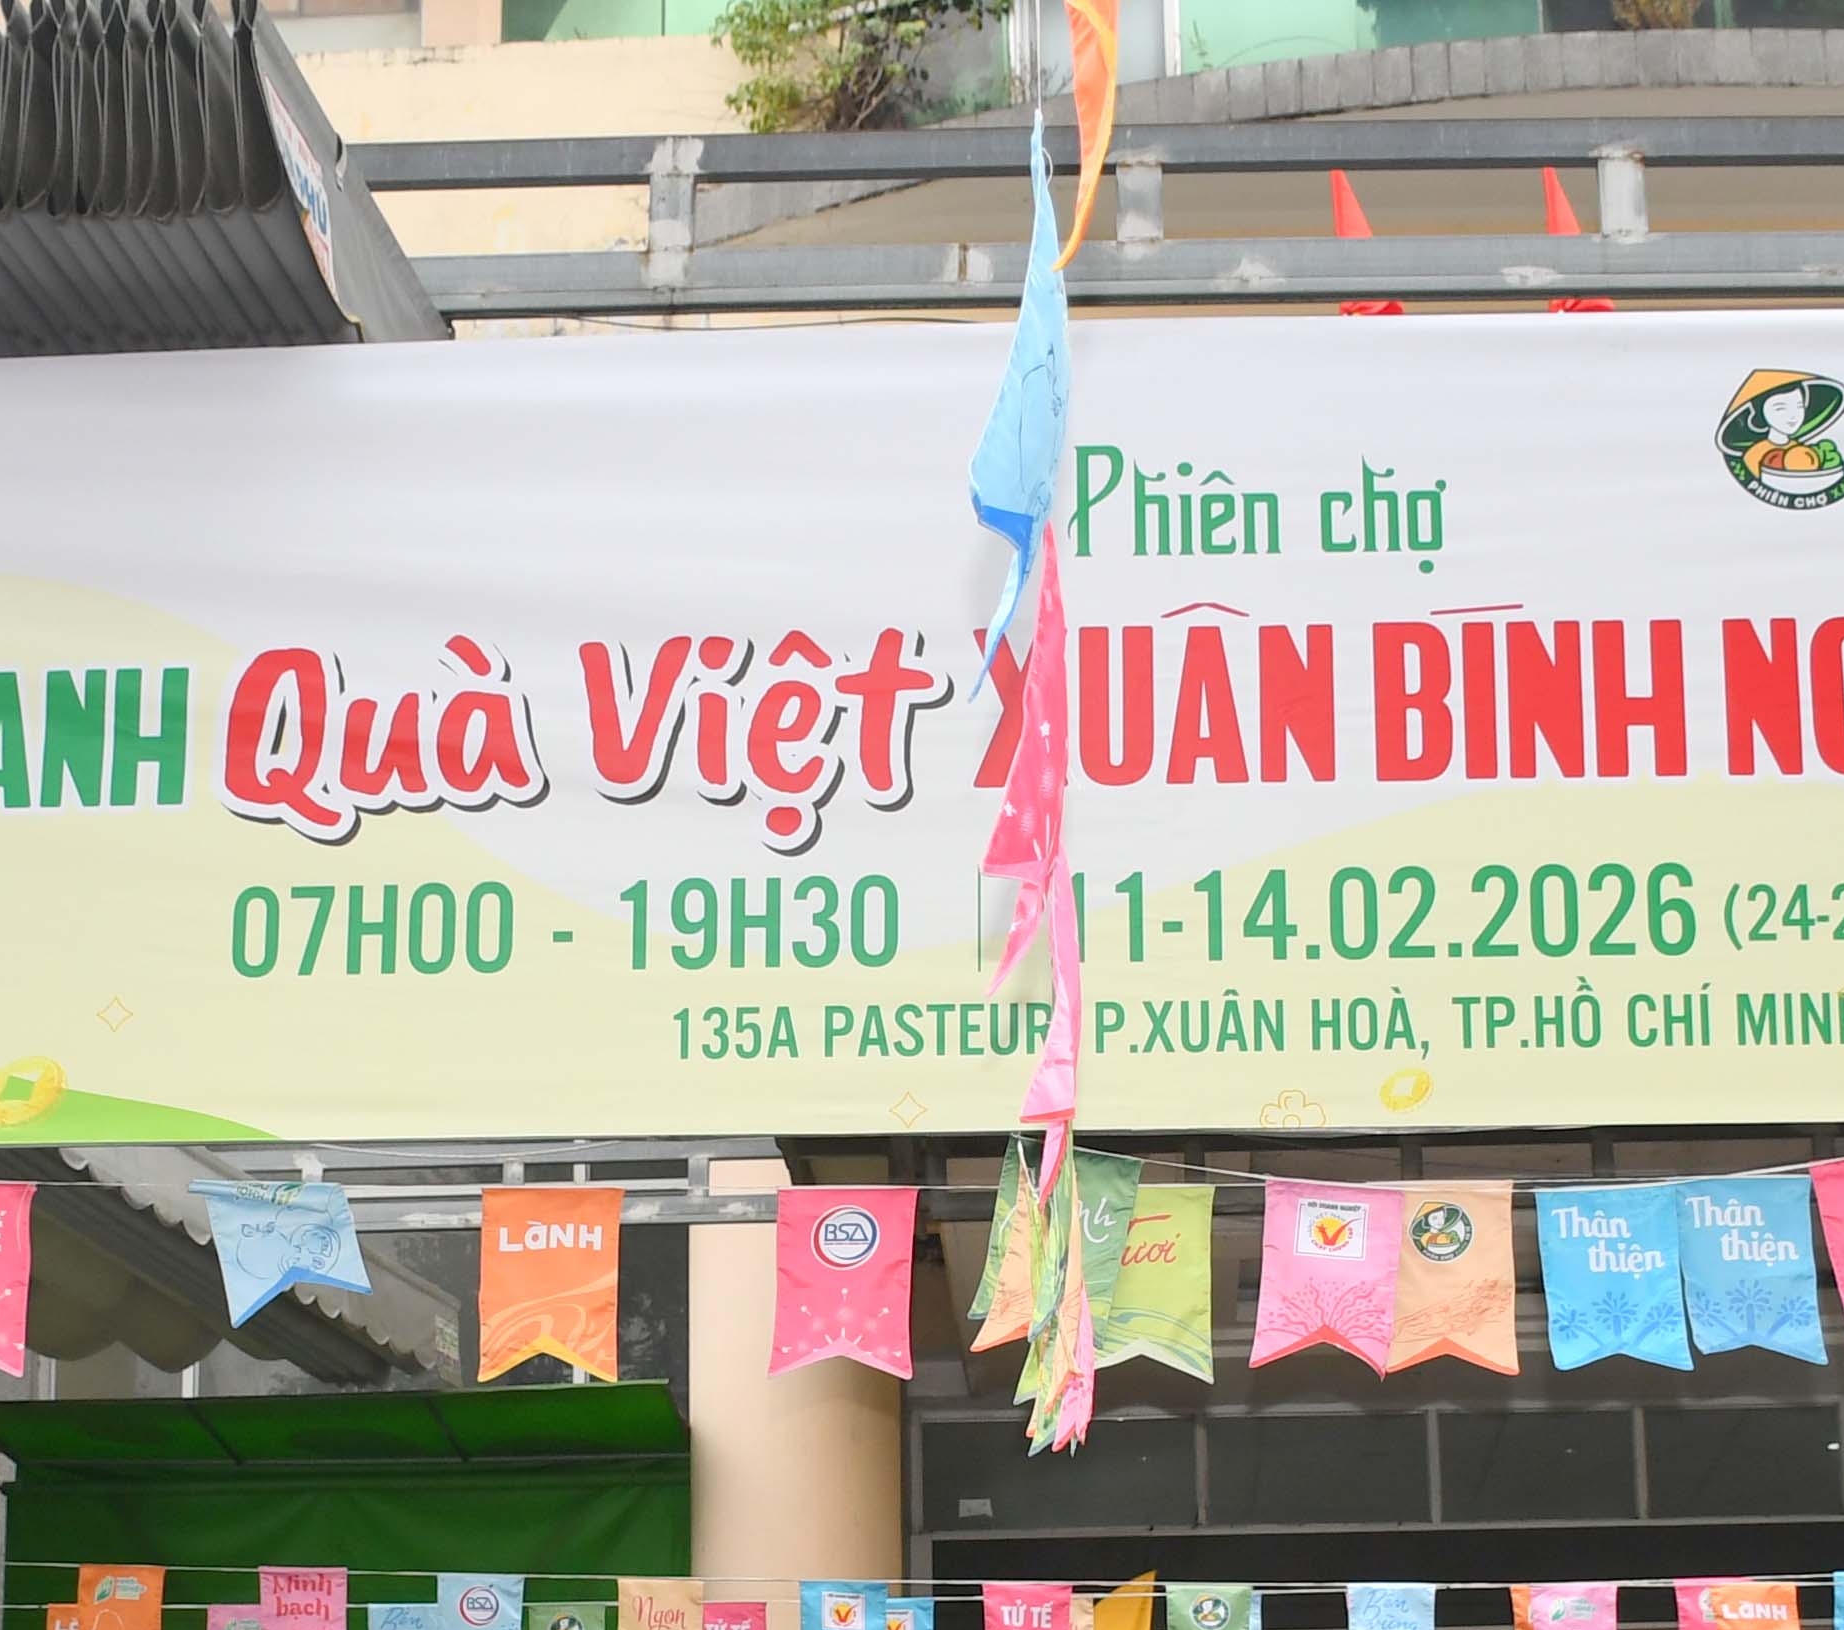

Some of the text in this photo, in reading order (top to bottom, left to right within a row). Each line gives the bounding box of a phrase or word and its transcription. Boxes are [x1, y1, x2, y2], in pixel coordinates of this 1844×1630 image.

[1070, 443, 1446, 575] Phiên chợ
[225, 635, 535, 826] Quà
[579, 628, 941, 842] Việt
[231, 879, 515, 978] 07H00
[627, 874, 899, 974] 19H30
[673, 1006, 799, 1061] 135A
[1094, 989, 1287, 1055] P.XUÂN
[1311, 991, 1429, 1059] HOÀ,
[1451, 976, 1601, 1051] TP.HỒ
[1621, 981, 1710, 1047] CHÍ
[1552, 1207, 1631, 1241] Thân
[1685, 1194, 1765, 1228] Thân
[823, 1223, 868, 1243] BSA
[1720, 1230, 1799, 1266] thiện
[1589, 1241, 1666, 1277] thiện
[273, 1574, 334, 1597] Minh
[275, 1599, 331, 1621] bạch
[1000, 1597, 1054, 1630] TỬ TẾ
